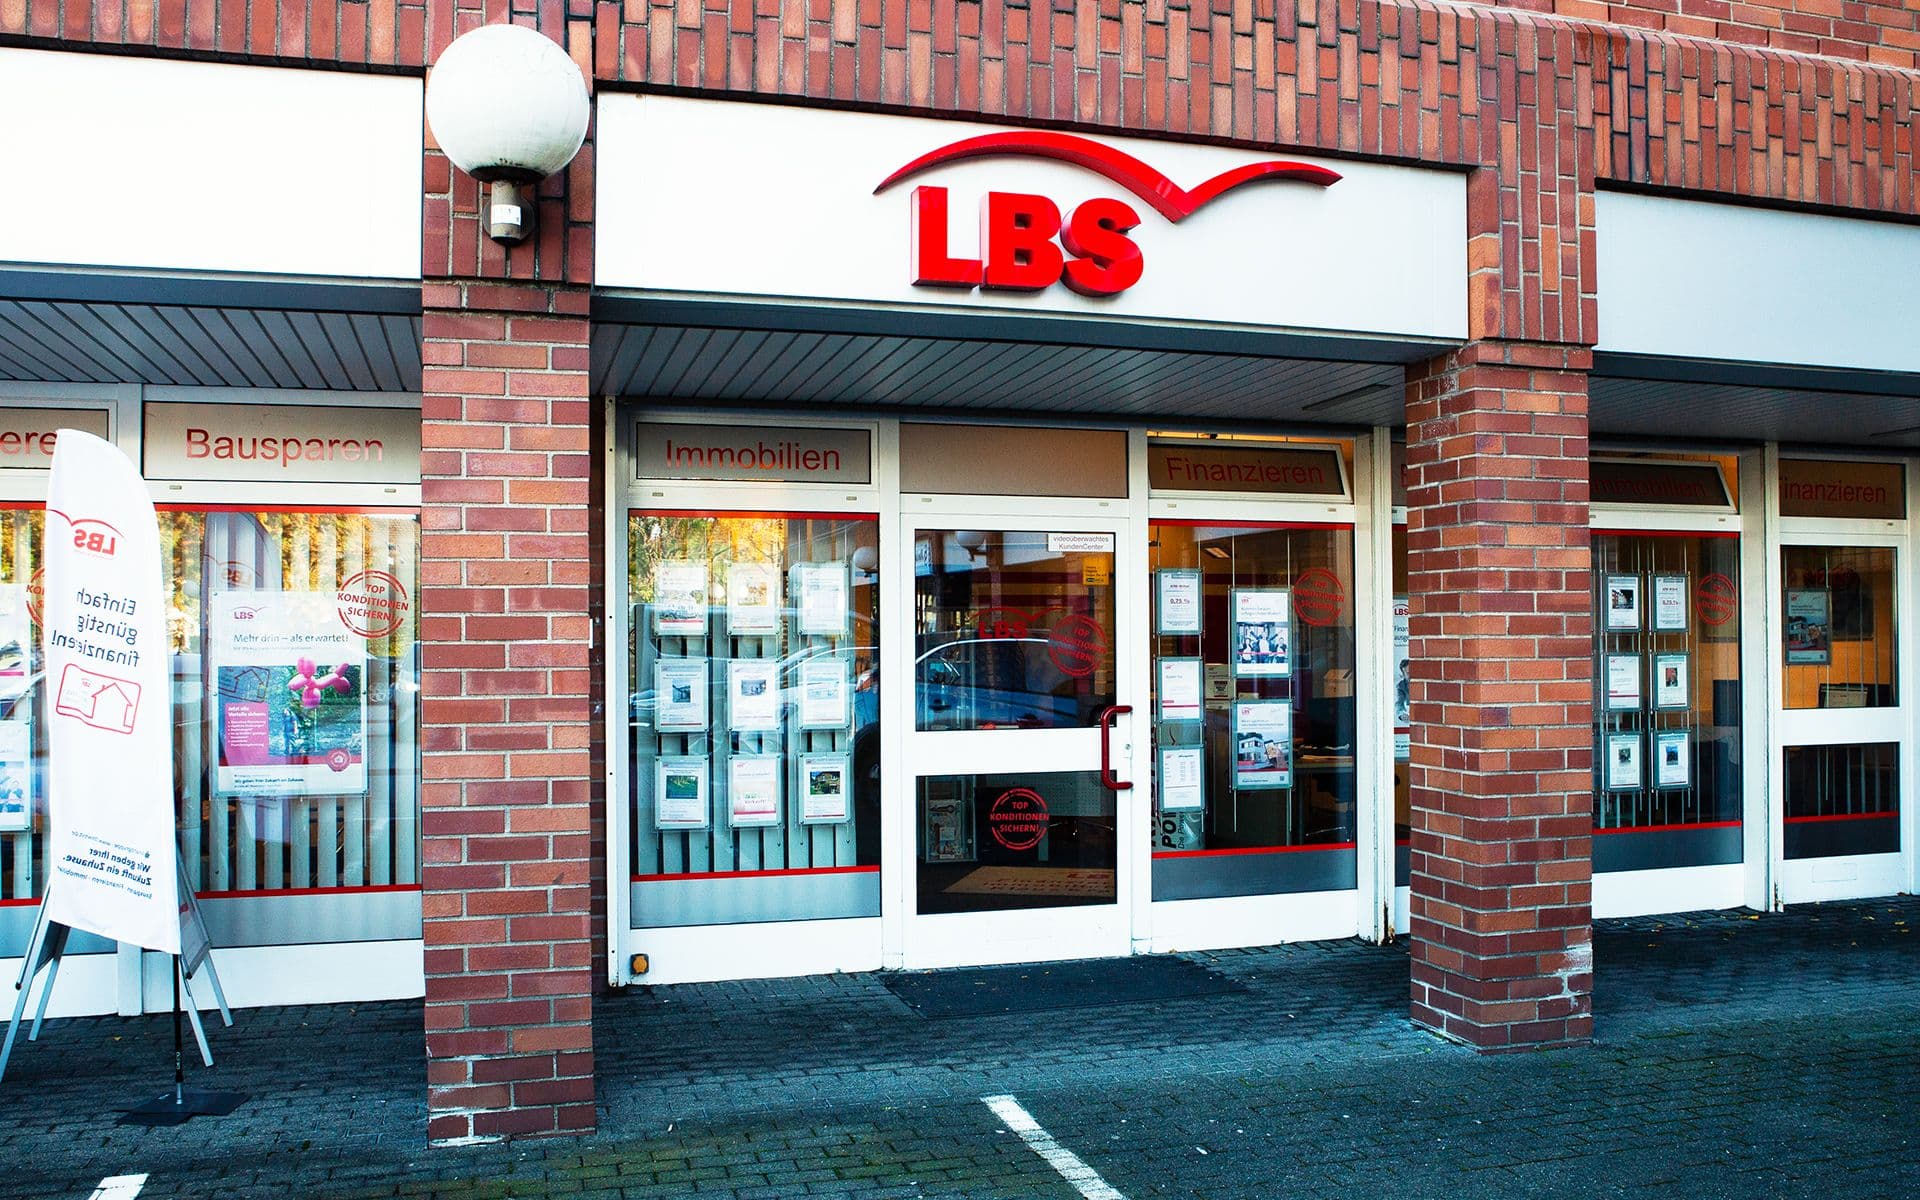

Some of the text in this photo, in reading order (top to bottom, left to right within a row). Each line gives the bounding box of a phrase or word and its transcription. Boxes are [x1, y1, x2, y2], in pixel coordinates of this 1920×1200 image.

[911, 185, 1144, 298] LBS
[186, 428, 384, 467] Bausparen
[667, 440, 840, 470] Immobilien
[1166, 457, 1325, 484] Finanzieren
[366, 584, 386, 594] TOP
[337, 592, 409, 611] KONDITIONEN
[233, 611, 254, 620] LBS
[347, 606, 395, 621] SICHERN!
[978, 620, 1028, 639] LBS
[233, 633, 259, 643] Mehr
[290, 633, 303, 643] als
[1011, 801, 1029, 810] TOP
[990, 812, 1049, 821] KONDITIONEN
[999, 824, 1039, 832] SICHERN!
